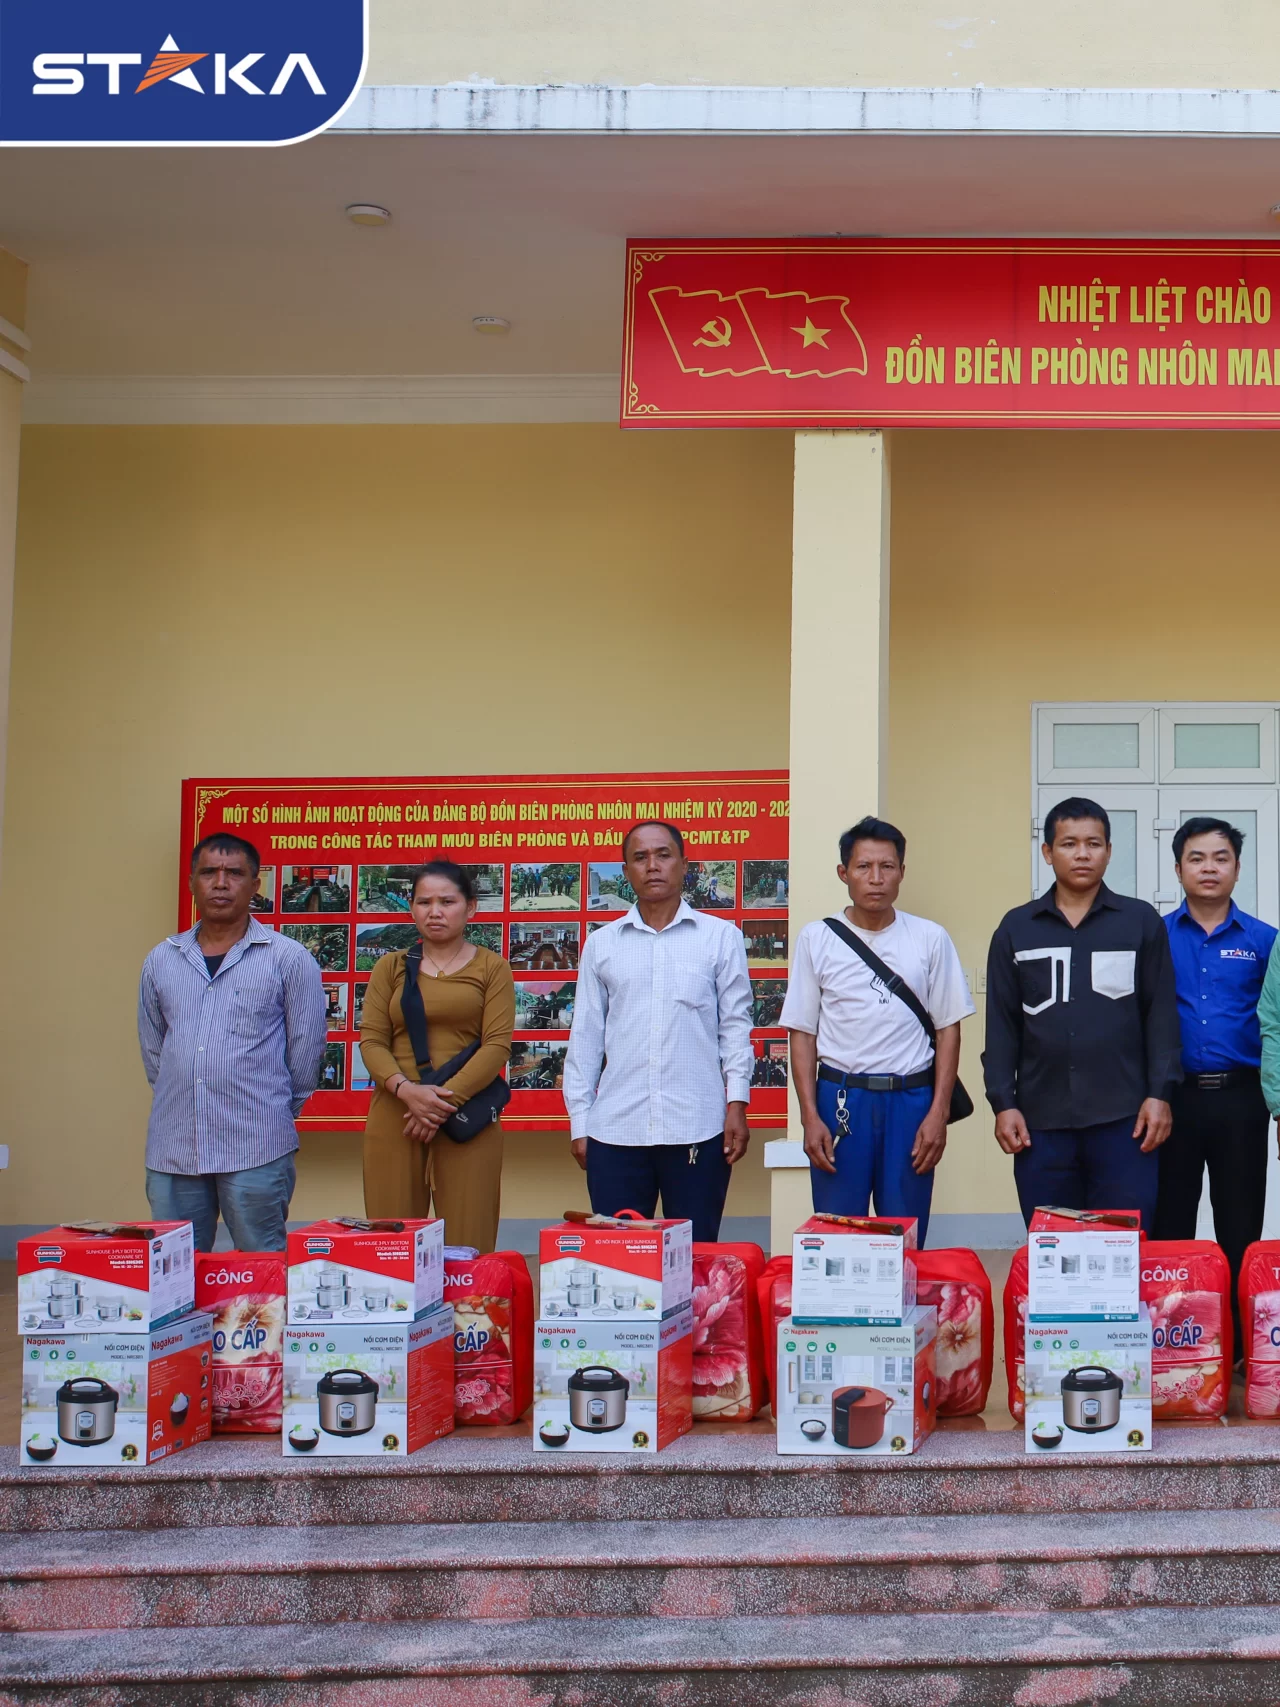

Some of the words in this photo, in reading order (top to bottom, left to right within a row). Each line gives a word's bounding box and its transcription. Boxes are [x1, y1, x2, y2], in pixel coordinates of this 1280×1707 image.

[1038, 277, 1121, 332] NHIỆT
[1129, 277, 1185, 332] LIỆT
[1195, 278, 1271, 324] CHÀO
[885, 333, 945, 385] ĐỒN
[955, 338, 1021, 385] BIÊN
[1031, 337, 1128, 386] PHÒNG
[1137, 339, 1218, 386] NHÔN
[223, 804, 249, 827] MỘT
[252, 801, 269, 823] SỐ
[272, 803, 301, 823] HÌNH
[304, 801, 330, 823] ẢNH
[334, 806, 364, 826] HOẠT
[368, 802, 401, 826] ĐỘNG
[405, 800, 429, 822] CỦA
[433, 800, 466, 821] ĐẢNG
[470, 801, 486, 825] BỘ
[490, 799, 515, 821] ĐỒN
[520, 801, 548, 820] BIÊN
[552, 800, 593, 820] PHÒNG
[598, 800, 631, 819] NHÔN
[636, 803, 659, 819] MAI
[664, 798, 703, 822] NHIỆM
[708, 798, 723, 818] KỲ
[727, 801, 757, 817] 2020
[769, 801, 789, 817] 202
[270, 836, 317, 849] TRONG
[322, 832, 361, 848] CÔNG
[365, 832, 392, 848] TÁC
[397, 834, 437, 848] THAM
[442, 832, 474, 847] MƯU
[479, 831, 512, 847] BIÊN
[517, 830, 566, 846] PHÒNG
[571, 830, 590, 846] VÀ
[594, 827, 623, 846] ĐẤU
[1220, 948, 1256, 957] STAKA
[205, 1268, 254, 1285] CÔNG
[444, 1273, 474, 1288] ÔNG
[1142, 1267, 1189, 1283] CÔNG
[230, 1320, 267, 1351] CẤP
[287, 1331, 325, 1339] Nagakawa
[409, 1326, 432, 1342] Nagakawa
[455, 1322, 489, 1352] CẤP
[538, 1327, 576, 1335] Nagakawa
[1169, 1316, 1203, 1346] CẤP
[26, 1338, 65, 1347] Nagakawa
[152, 1333, 183, 1351] Nagakawa
